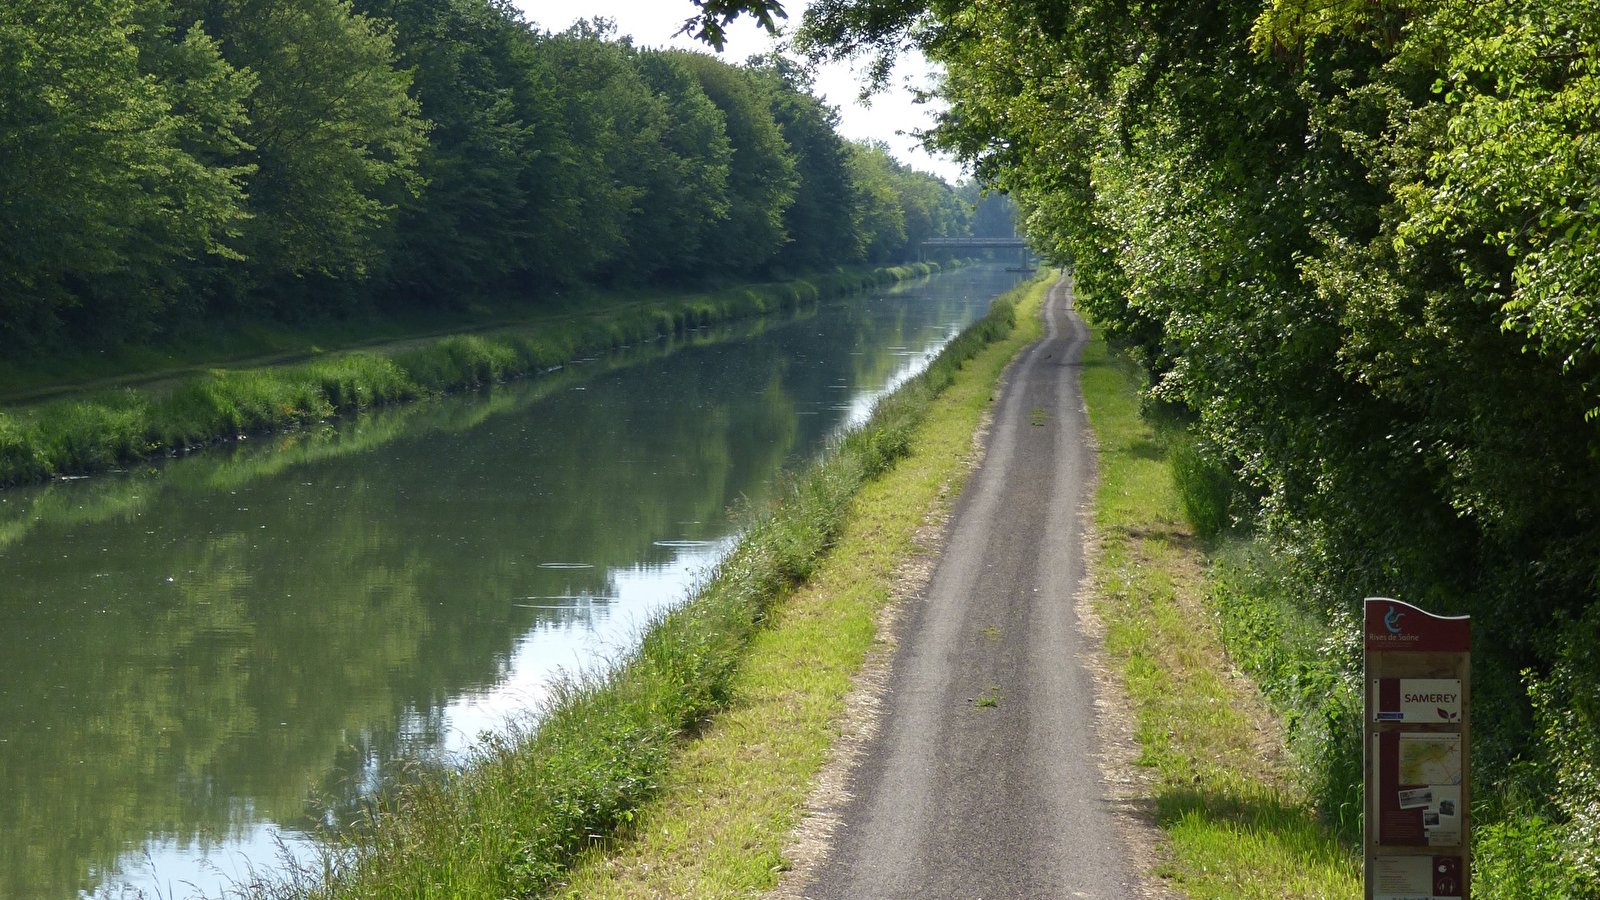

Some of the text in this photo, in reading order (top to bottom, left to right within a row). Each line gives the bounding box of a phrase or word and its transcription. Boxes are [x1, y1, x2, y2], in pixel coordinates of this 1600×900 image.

[1369, 633, 1420, 641] Rives de Saône
[1404, 693, 1457, 703] SAMEREY
